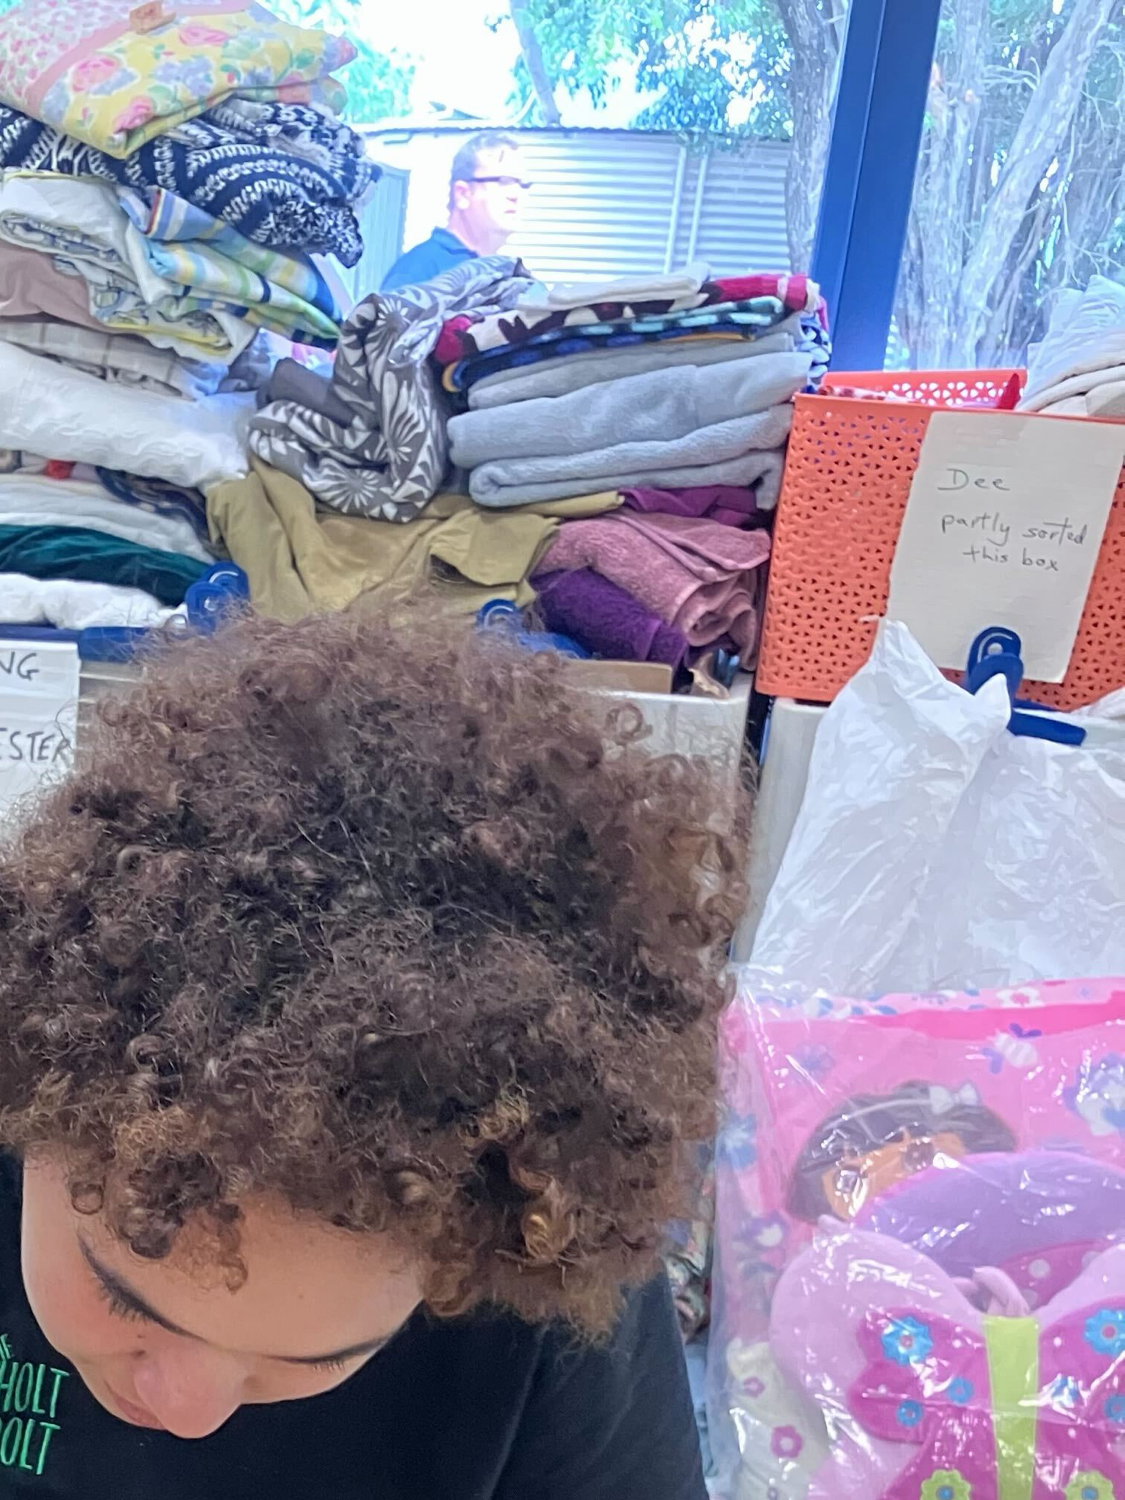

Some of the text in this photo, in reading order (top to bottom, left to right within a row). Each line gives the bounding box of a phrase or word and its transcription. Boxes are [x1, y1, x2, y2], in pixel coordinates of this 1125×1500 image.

[937, 468, 1010, 491] Dee
[942, 512, 1088, 547] partly sorted
[962, 545, 1059, 572] this box
